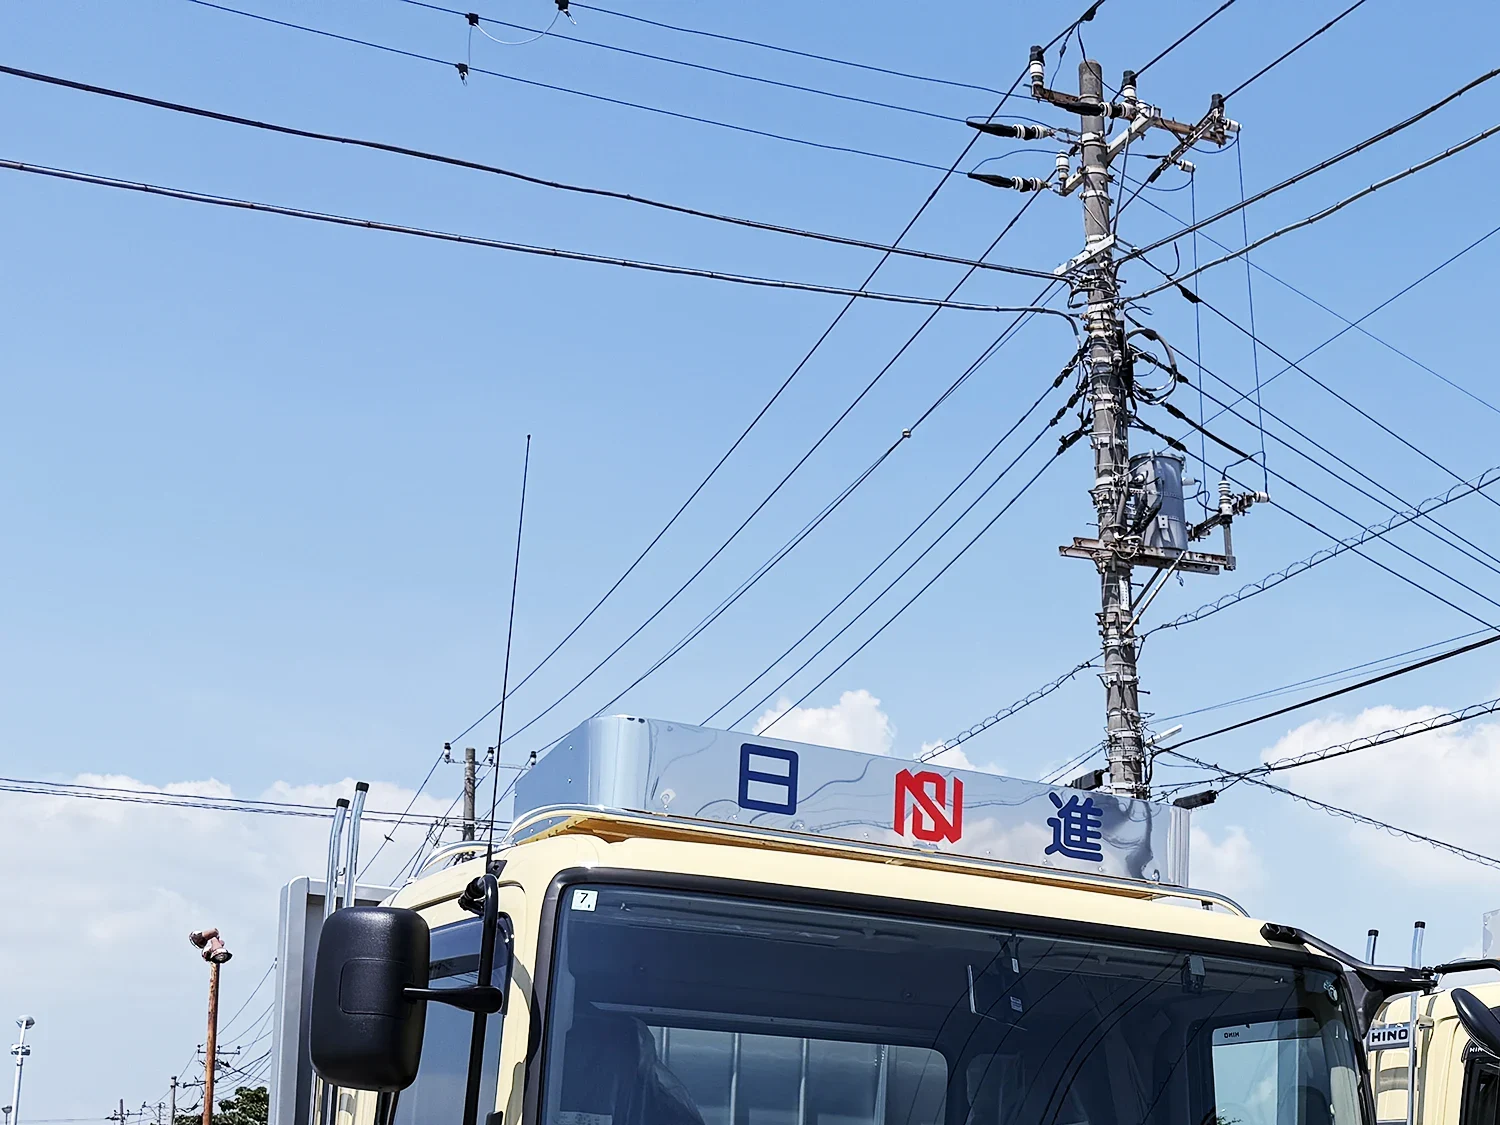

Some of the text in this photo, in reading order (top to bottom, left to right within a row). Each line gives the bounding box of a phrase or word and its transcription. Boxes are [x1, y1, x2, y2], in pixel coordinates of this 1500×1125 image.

[738, 742, 799, 816] 日
[1044, 791, 1104, 863] 進
[1371, 1028, 1409, 1043] HINO
